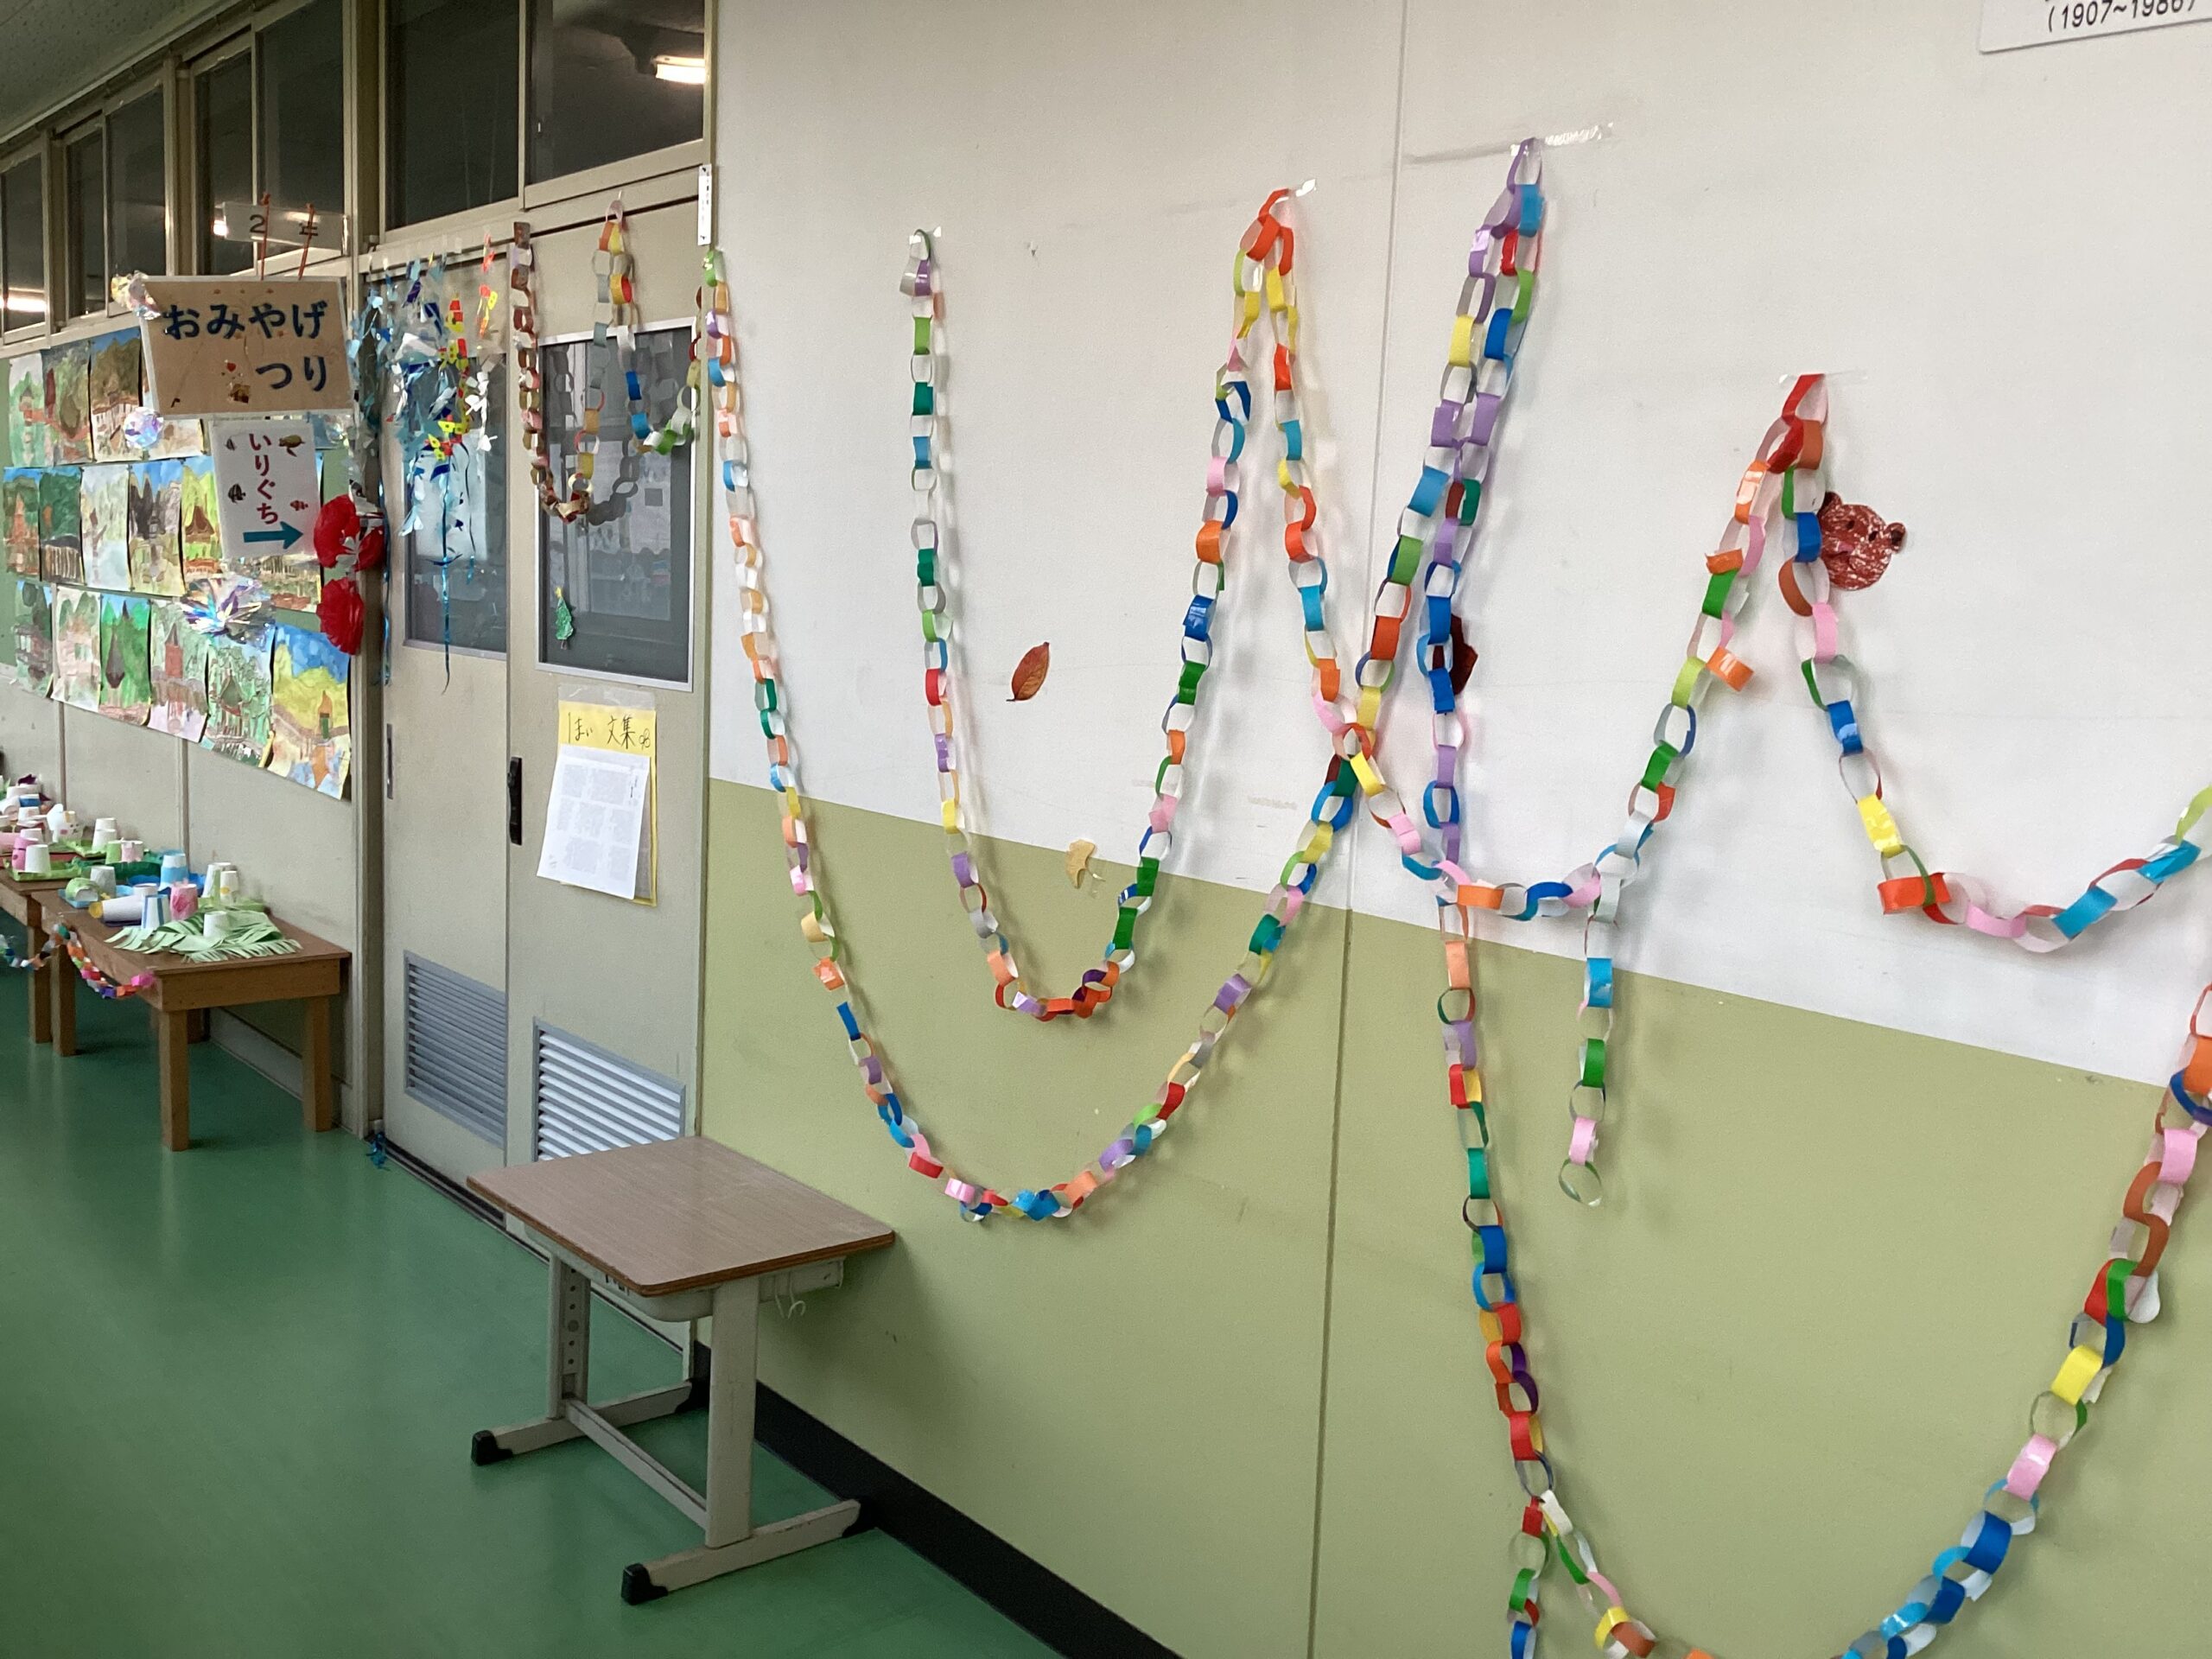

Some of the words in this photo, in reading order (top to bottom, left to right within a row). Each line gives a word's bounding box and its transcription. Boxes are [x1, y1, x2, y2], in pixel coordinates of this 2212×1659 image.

[162, 299, 328, 340] おみやげ
[255, 355, 327, 392] つり
[249, 433, 279, 525] いりぐち
